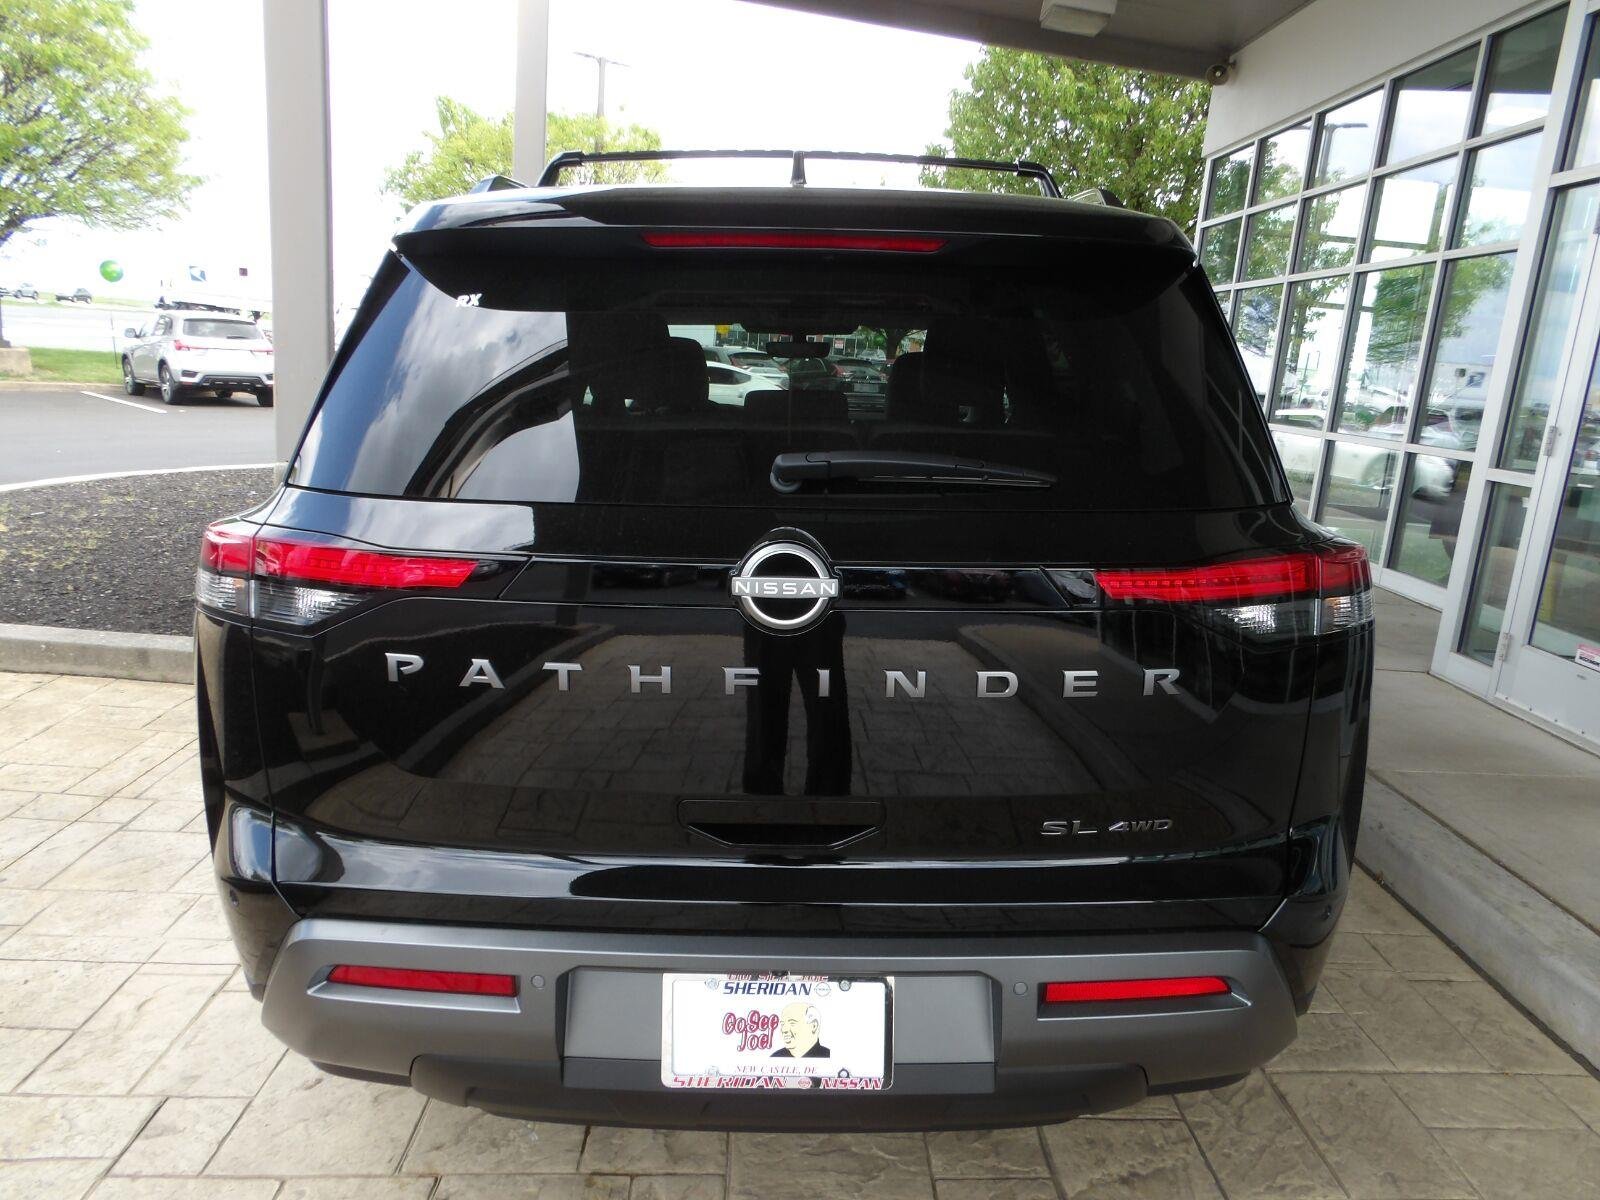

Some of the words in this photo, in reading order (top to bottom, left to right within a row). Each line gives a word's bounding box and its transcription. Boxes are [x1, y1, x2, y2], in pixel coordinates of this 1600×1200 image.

[735, 581, 836, 595] NISSAN
[385, 652, 1181, 698] PATHFINDER
[1041, 820, 1098, 835] SL
[1108, 819, 1173, 832] 4WD
[723, 982, 812, 996] SHERIDAN
[737, 1029, 772, 1052] Joel
[736, 1065, 757, 1073] NEW
[804, 1066, 817, 1075] DE
[673, 1076, 787, 1088] SHERIDAN
[820, 1077, 883, 1089] NISSAN
